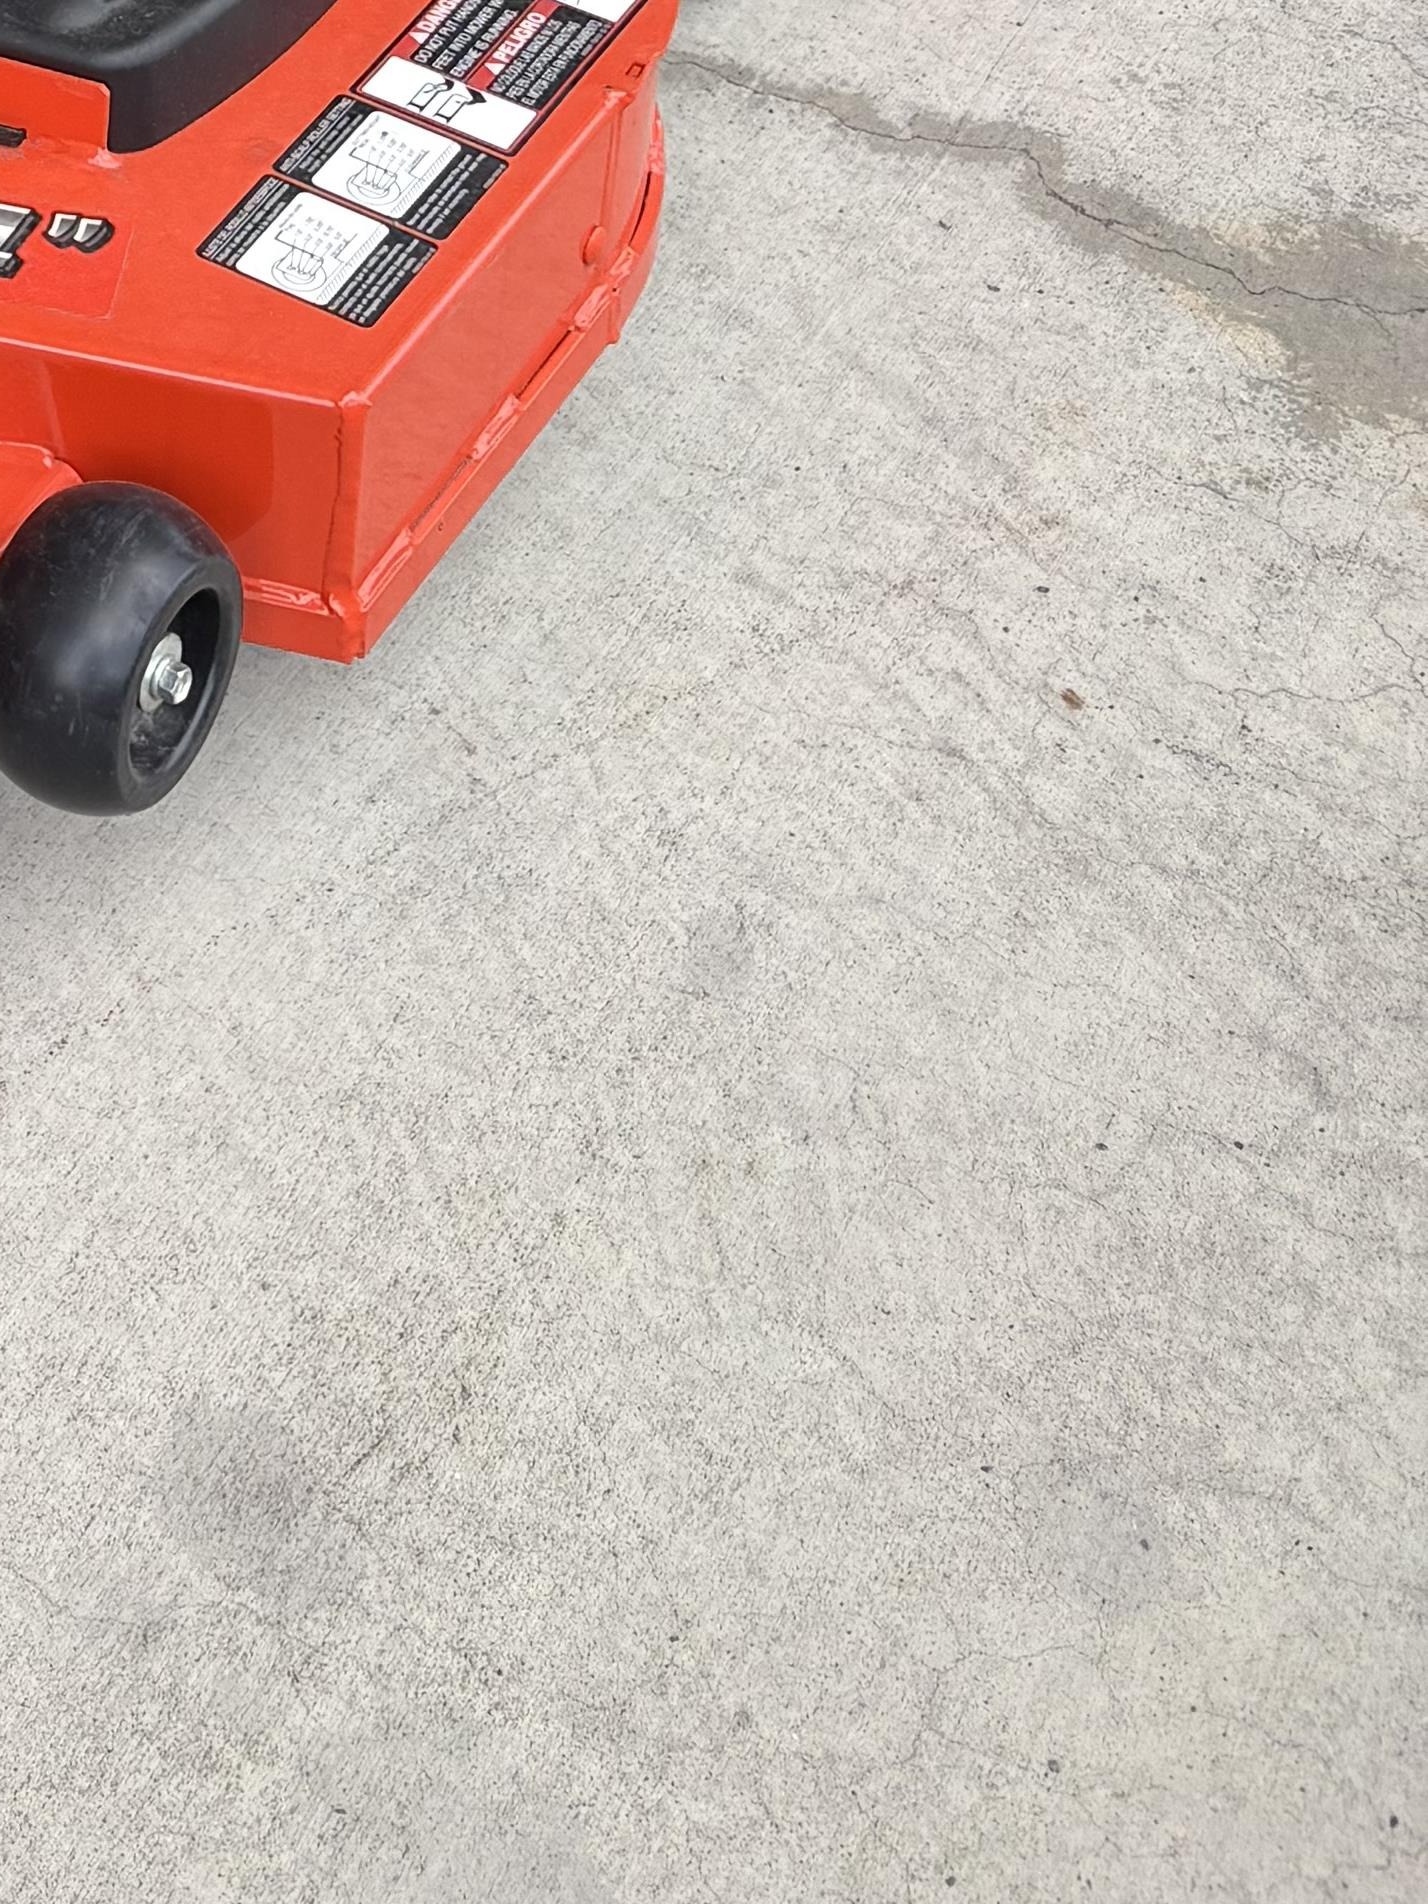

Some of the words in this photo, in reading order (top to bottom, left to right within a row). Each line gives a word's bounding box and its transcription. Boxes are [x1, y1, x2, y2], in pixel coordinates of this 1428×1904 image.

[412, 48, 433, 63] DO
[423, 34, 447, 51] NOT
[437, 20, 460, 36] PUT
[429, 48, 458, 70] FEET
[446, 31, 473, 52] INTO
[462, 5, 498, 35] MOWER
[490, 10, 549, 62] PELIGRO
[448, 47, 484, 77] ENGINE
